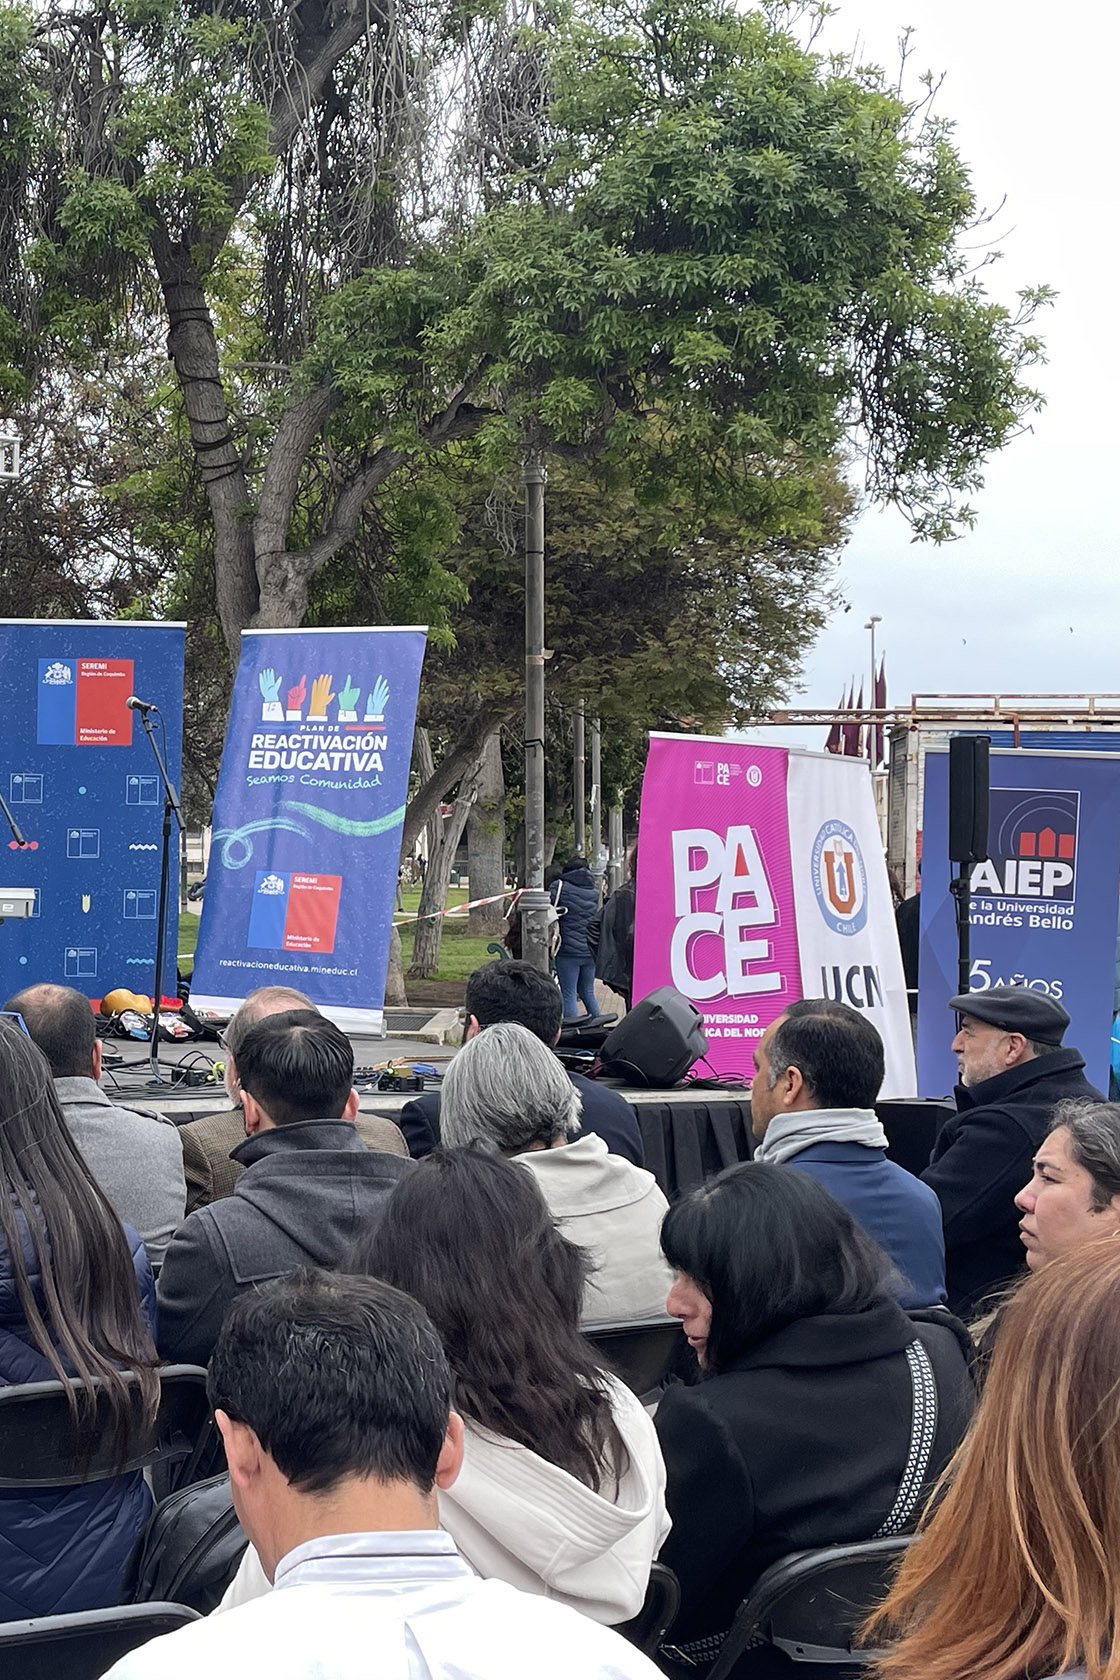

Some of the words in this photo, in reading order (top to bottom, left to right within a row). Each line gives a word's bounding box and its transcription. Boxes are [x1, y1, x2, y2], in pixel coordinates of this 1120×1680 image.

[251, 732, 388, 751] REACTIVACIÓN
[248, 750, 384, 772] EDUCATIVA
[300, 774, 382, 789] Comunidad
[294, 876, 318, 884] SEREMI
[970, 858, 1074, 897] AIEP
[981, 901, 992, 911] la
[997, 902, 1074, 915] Universidad
[836, 922, 856, 933] CHILE
[1029, 915, 1073, 930] Bello
[219, 959, 358, 976] reactivacioneducativa.mineduc.cl
[724, 1028, 743, 1037] DEL
